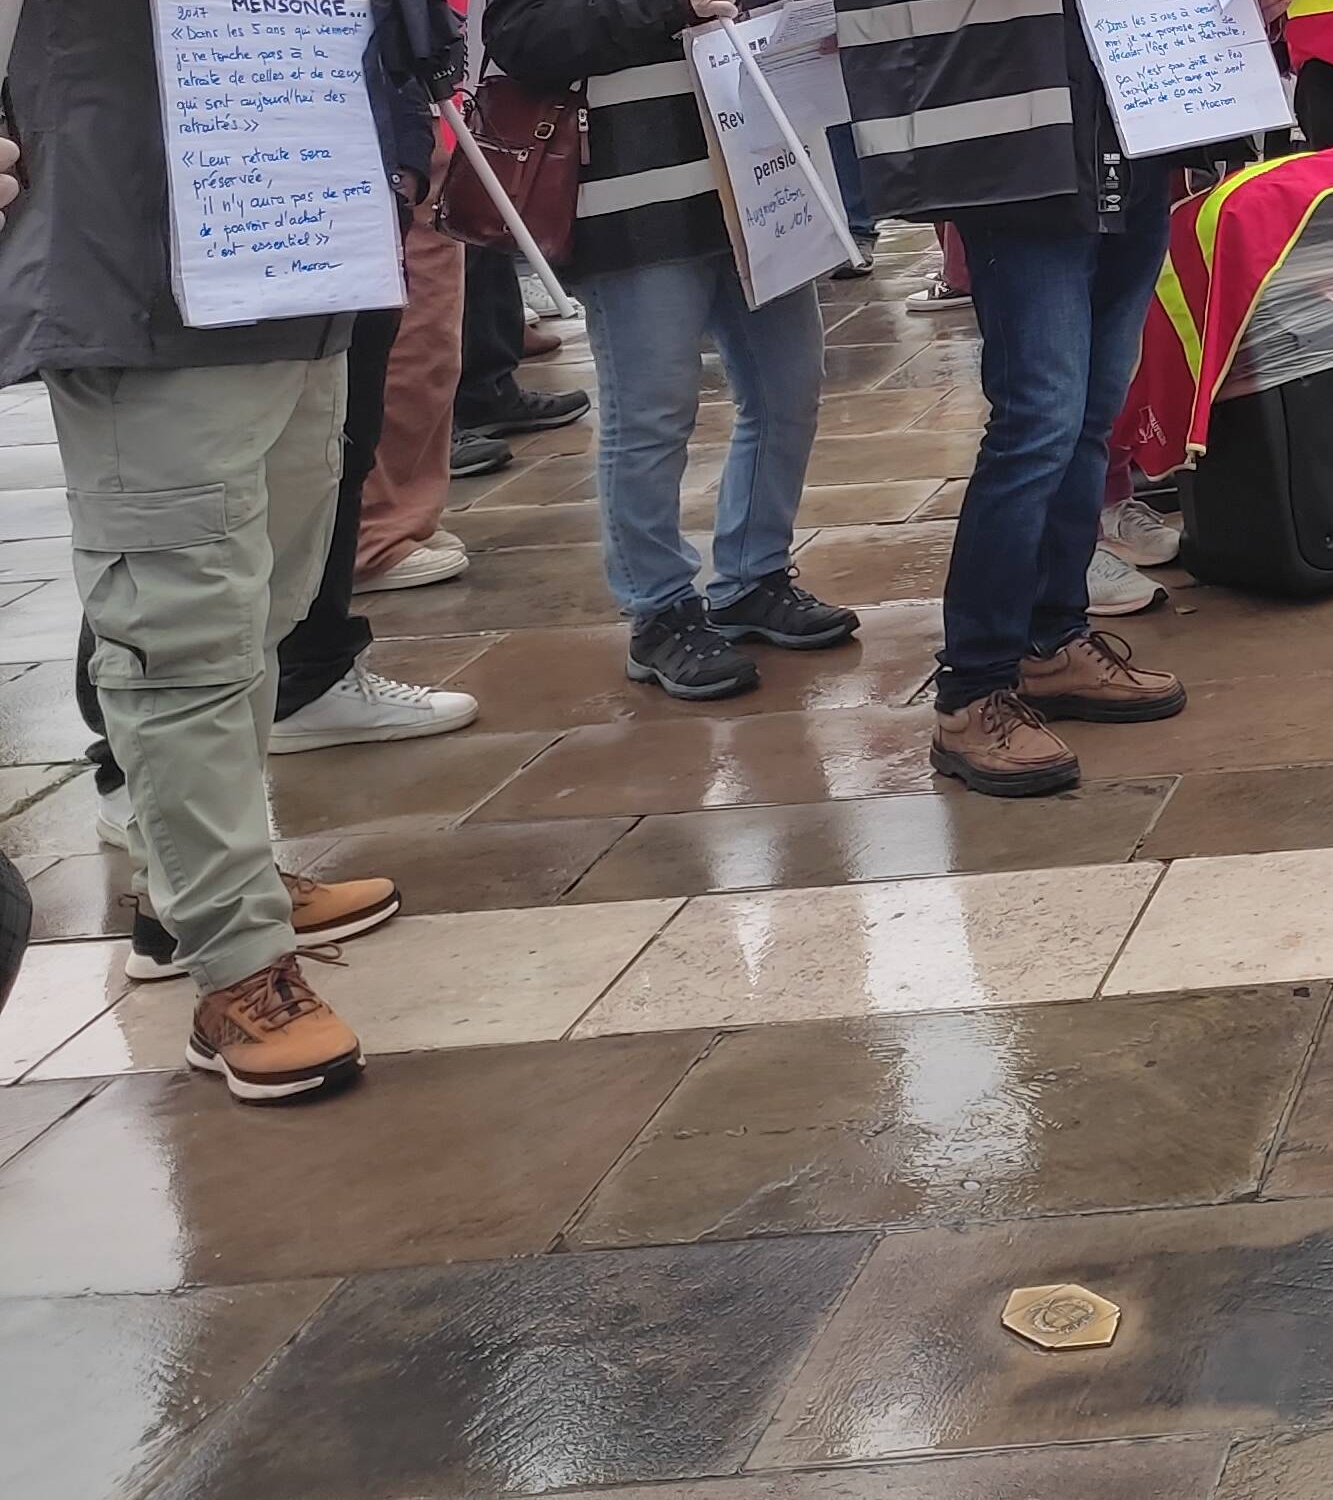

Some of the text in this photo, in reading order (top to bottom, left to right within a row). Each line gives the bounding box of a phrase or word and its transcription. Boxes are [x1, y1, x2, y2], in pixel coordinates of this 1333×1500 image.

[226, 23, 245, 38] les
[250, 22, 262, 35] 5
[266, 25, 286, 37] ans
[294, 24, 311, 41] qui
[257, 48, 284, 66] pas
[177, 66, 363, 88] retraite de celles et de ceux
[176, 98, 199, 118] qui
[323, 91, 347, 105] des
[199, 150, 232, 168] Leur
[241, 147, 291, 165] retraite
[299, 147, 333, 161] sera
[753, 143, 811, 186] pensios
[202, 195, 215, 217] il
[250, 197, 287, 210] aura
[292, 190, 315, 207] pas
[321, 185, 339, 200] de
[199, 221, 213, 239] de
